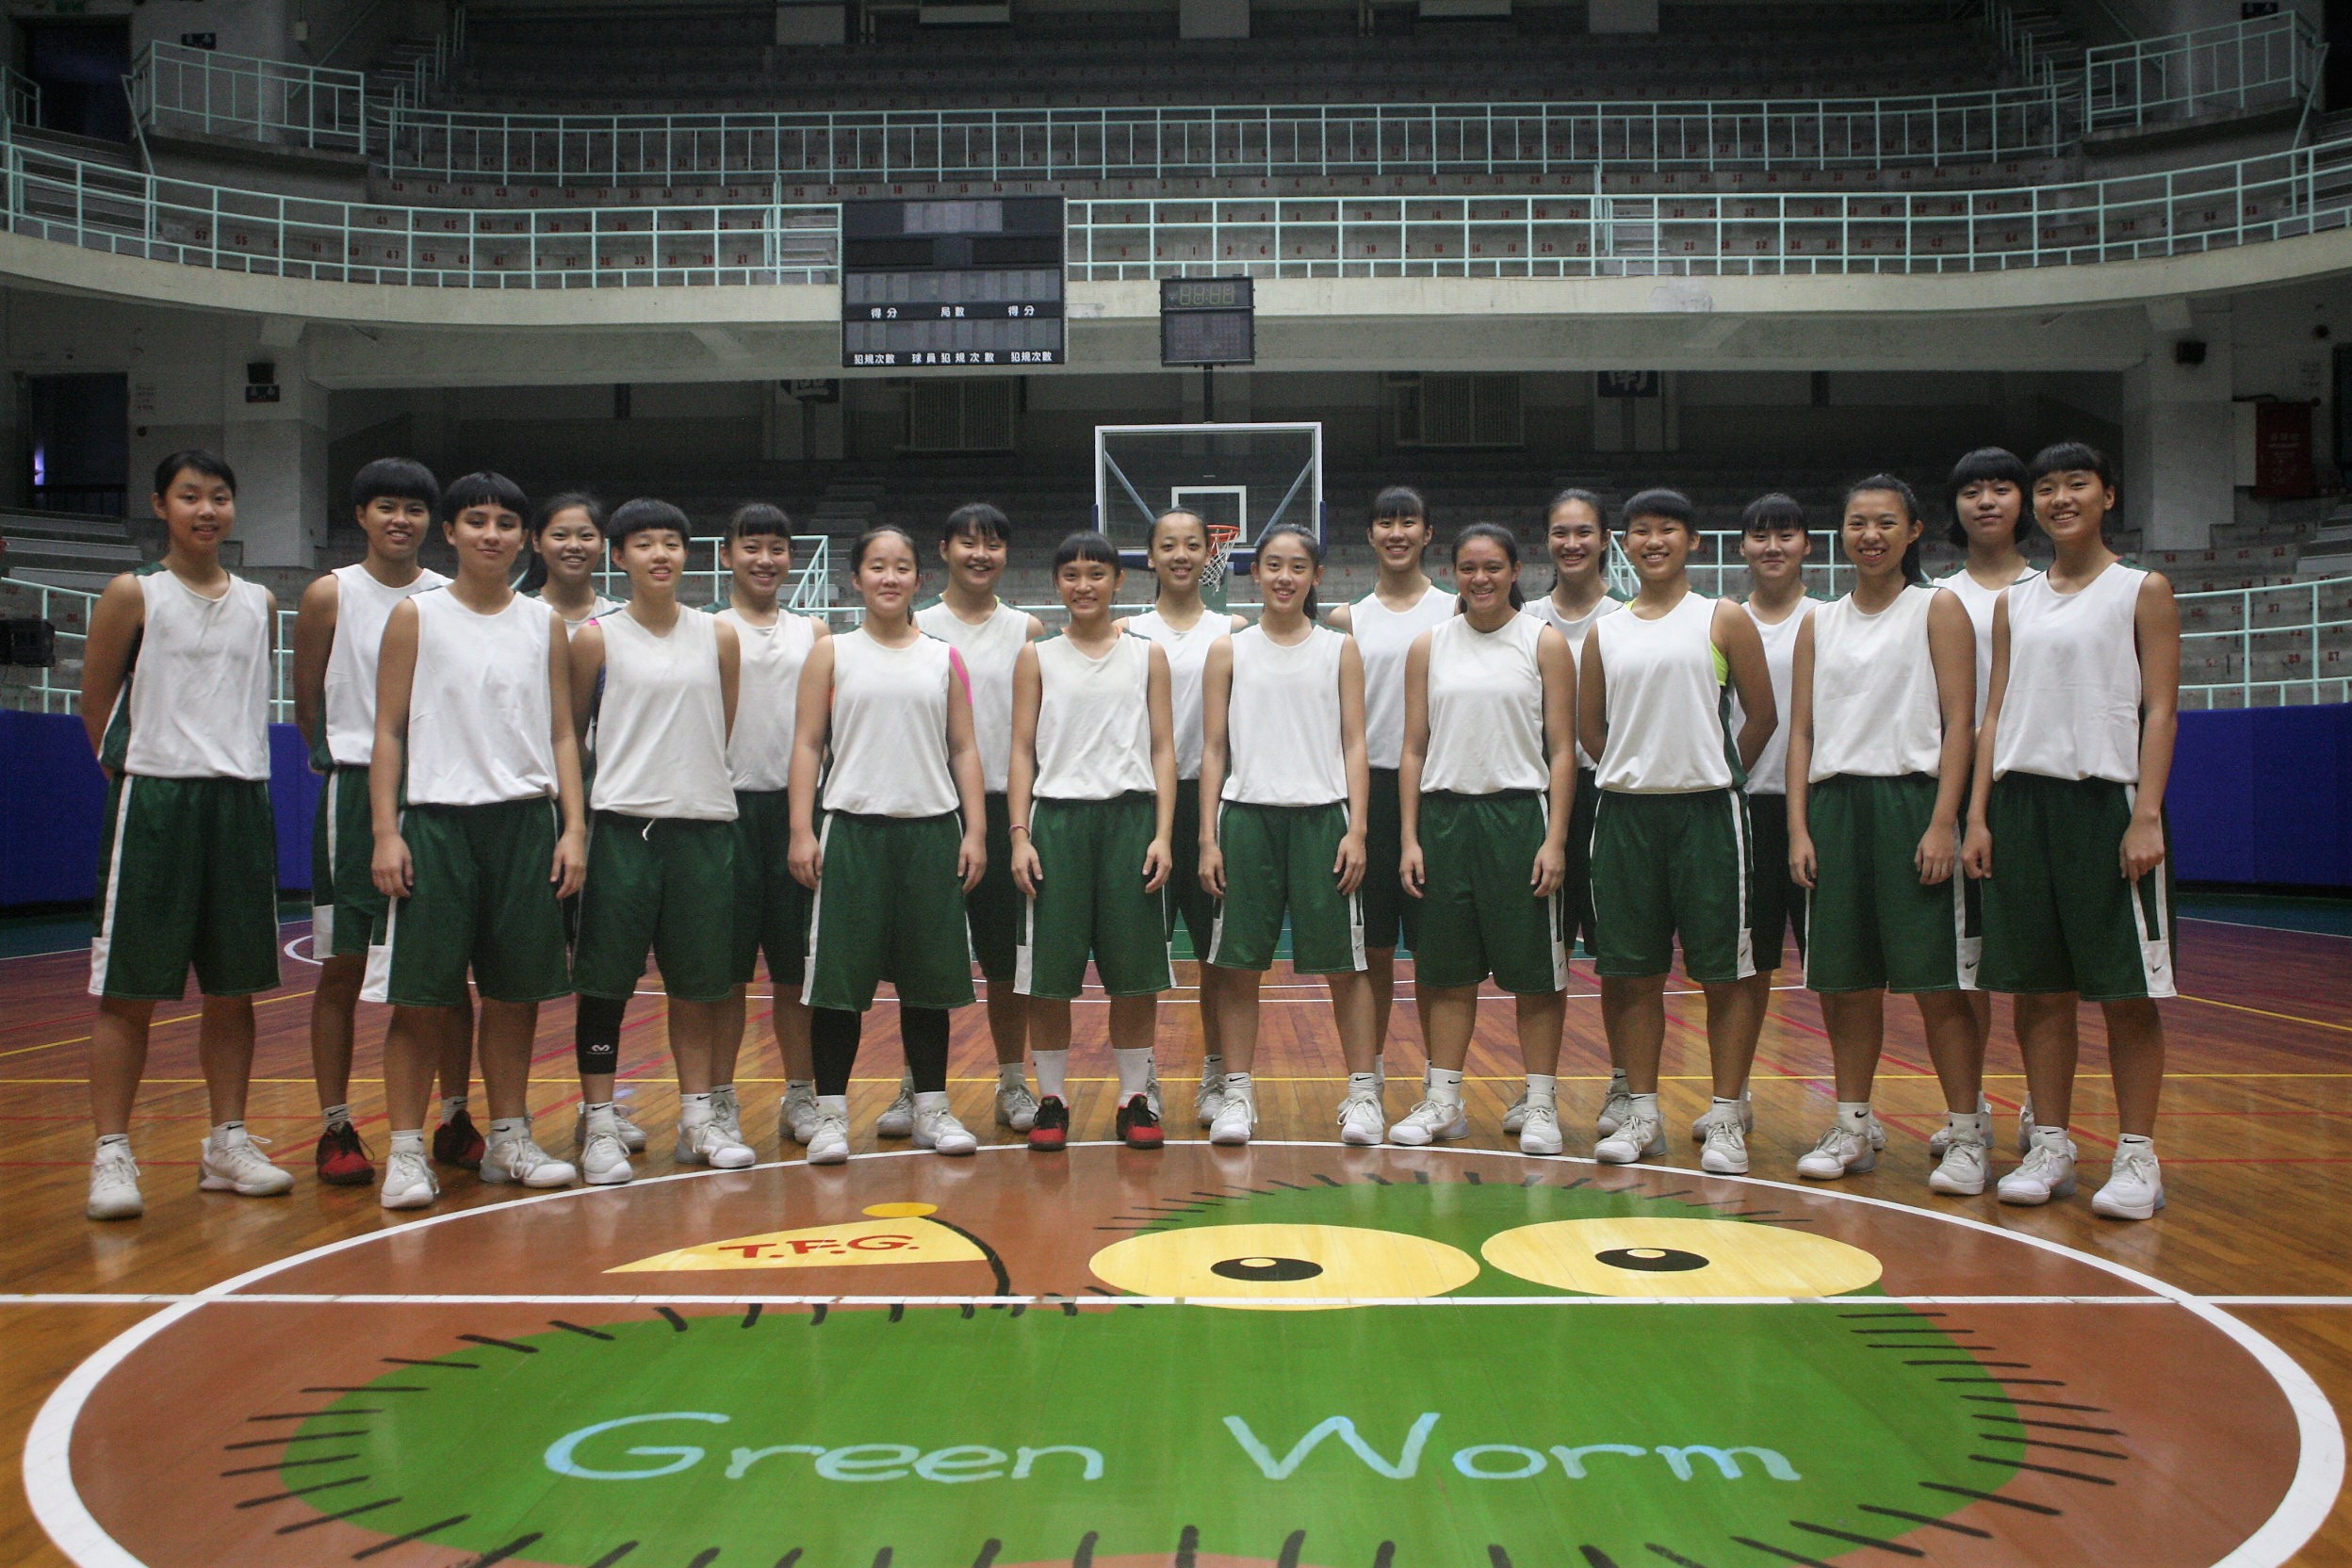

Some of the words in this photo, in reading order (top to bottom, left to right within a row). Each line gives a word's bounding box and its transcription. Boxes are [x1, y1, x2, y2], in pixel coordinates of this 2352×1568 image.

[871, 307, 898, 318] 得分
[1007, 305, 1035, 317] 得分
[719, 1233, 920, 1259] T.F.G.
[543, 1411, 1104, 1483] Green
[1222, 1412, 1802, 1481] Worm
